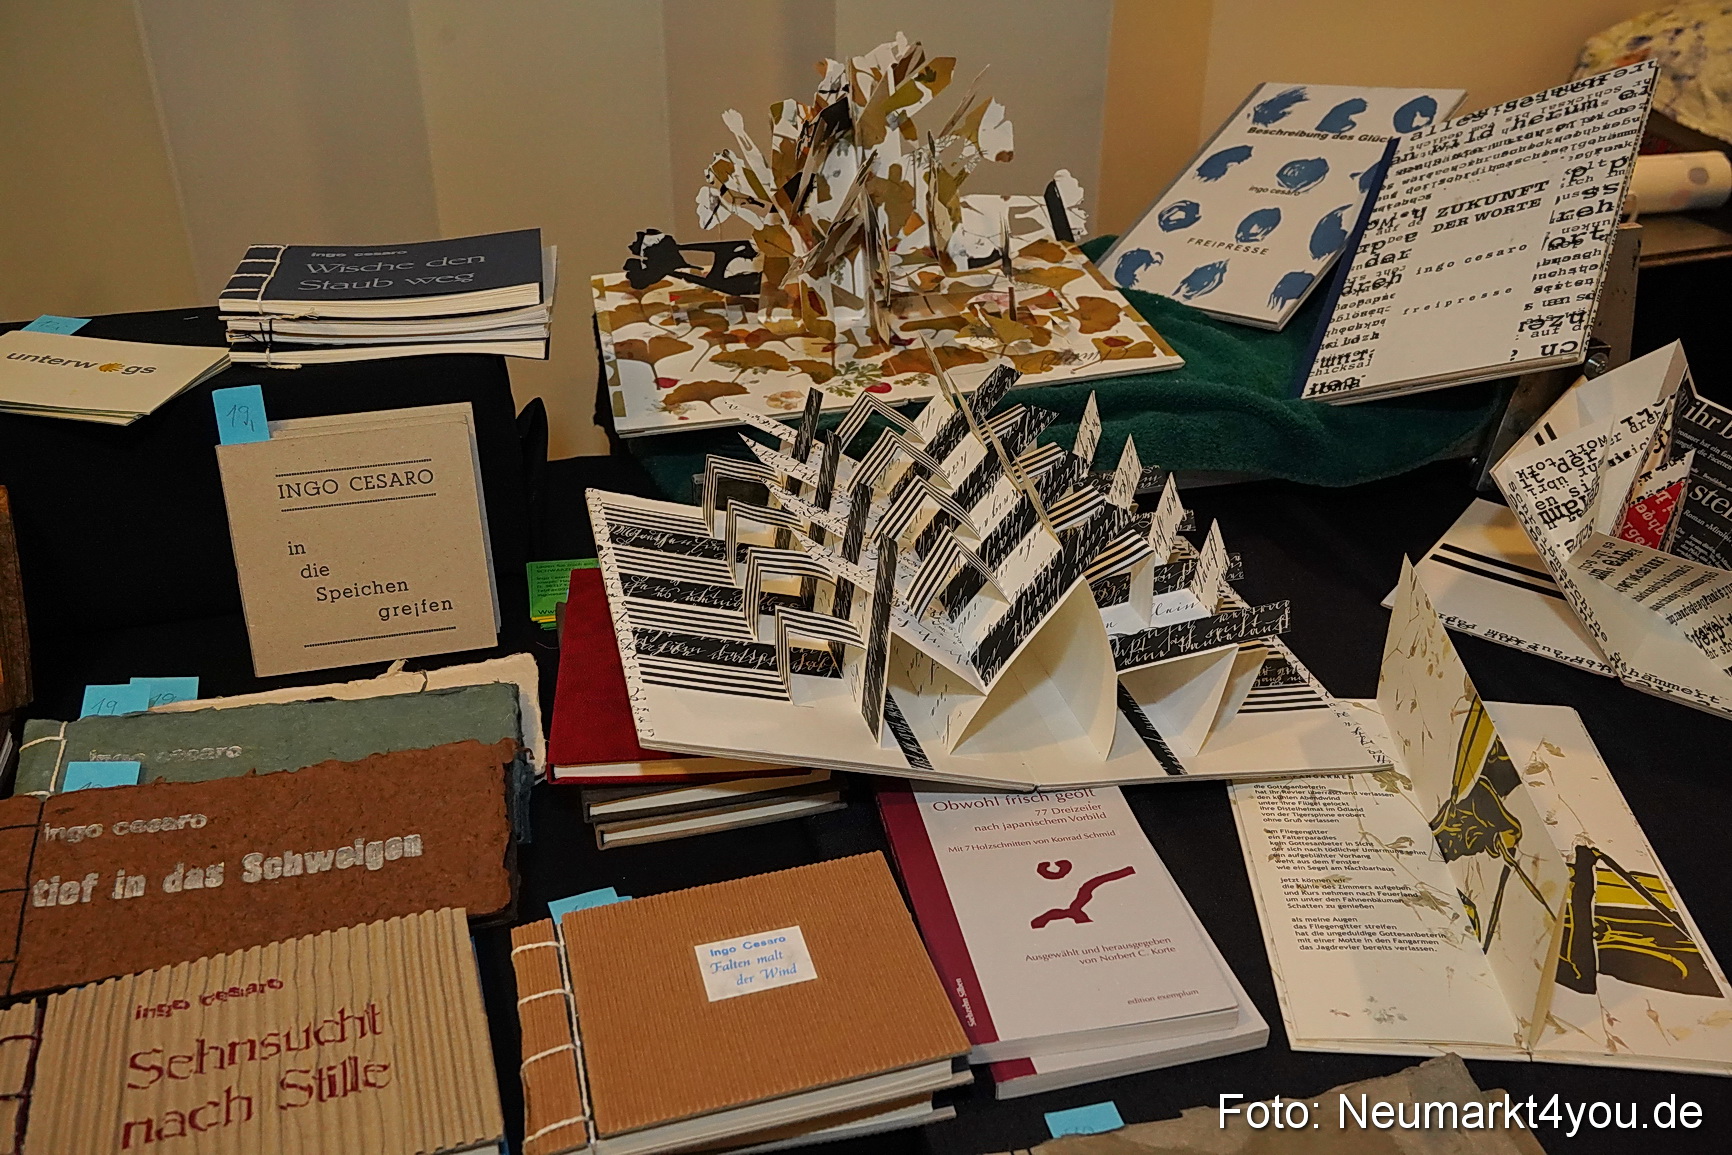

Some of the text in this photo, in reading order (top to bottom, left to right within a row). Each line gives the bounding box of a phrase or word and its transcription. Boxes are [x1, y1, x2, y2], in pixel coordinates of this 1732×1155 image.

[1247, 127, 1329, 140] Beschreibung
[1249, 186, 1269, 194] ingo
[1435, 180, 1550, 219] ZUKUNFT
[1431, 198, 1542, 234] DER WORTE
[1187, 237, 1269, 256] FREIPRESSE
[306, 254, 487, 274] Wische den
[1415, 243, 1528, 276] ingo cesaro
[298, 273, 475, 291] Staub weg
[1402, 286, 1513, 316] freipresse
[1683, 401, 1721, 430] ihr
[277, 468, 435, 499] INGO CESARO
[287, 540, 307, 556] in
[300, 564, 330, 579] die
[316, 579, 409, 602] Speichen
[932, 796, 1000, 812] Obwohl
[1005, 792, 1050, 805] frisch
[1052, 803, 1102, 815] Dreizeiler
[44, 822, 104, 843] ingo
[974, 812, 1107, 832] nach japanischem Vorbild
[971, 840, 1031, 850] Holzschnitten
[1032, 837, 1050, 845] von
[1051, 834, 1082, 843] Konrad
[1083, 830, 1116, 839] Schmid
[32, 833, 425, 908] tief in das Schweigen
[710, 936, 786, 957] Ingo Cesaro
[1025, 937, 1171, 963] Ausgewählt und herausgegeben
[1079, 957, 1098, 965] von
[1099, 951, 1136, 963] Norbert
[1150, 945, 1176, 956] Korte
[710, 950, 784, 974] Falten malt
[736, 963, 797, 986] der Wind
[134, 978, 284, 1020] ingo cesaro
[1127, 989, 1199, 1005] edition exemplum
[127, 1003, 382, 1090] Sehnsucht
[122, 1055, 391, 1149] nach Stille
